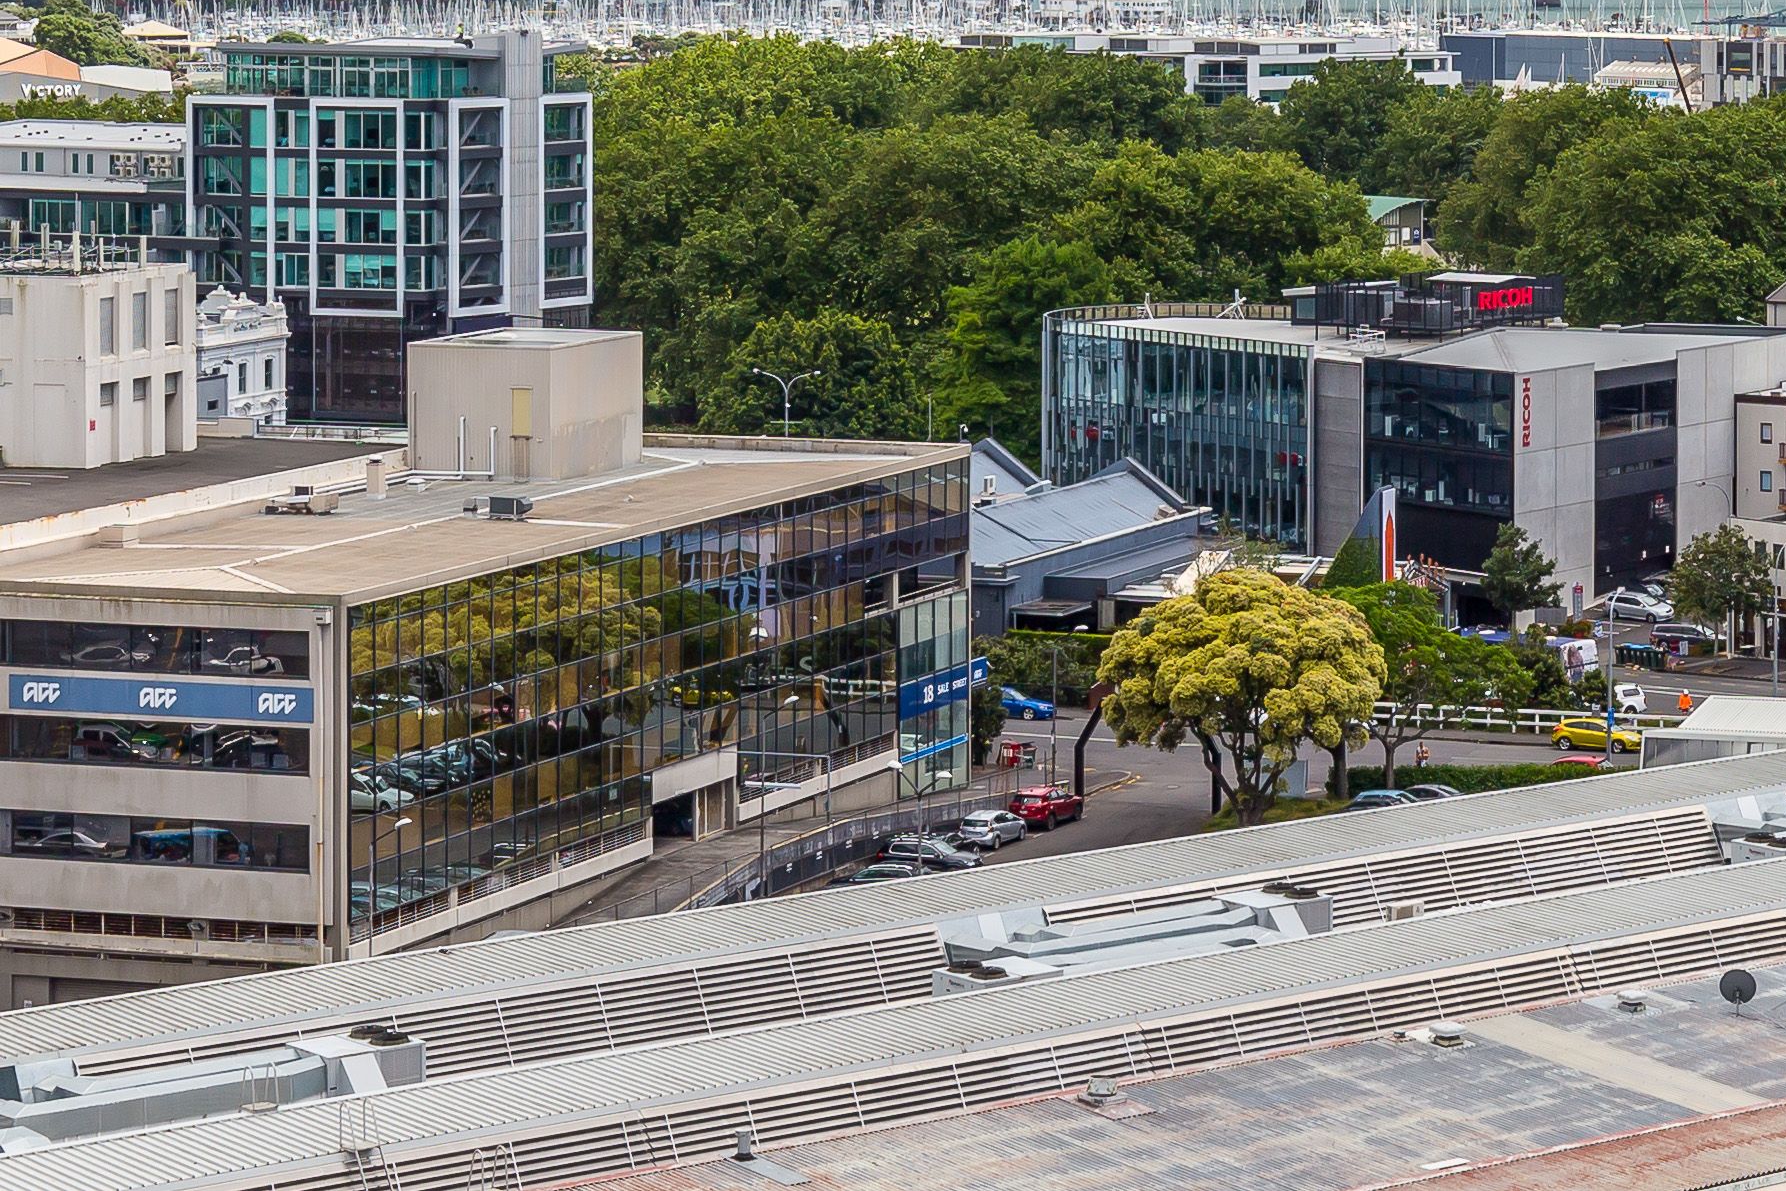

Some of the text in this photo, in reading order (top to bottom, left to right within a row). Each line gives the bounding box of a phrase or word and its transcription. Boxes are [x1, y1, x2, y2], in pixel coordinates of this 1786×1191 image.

[1477, 286, 1533, 310] RICOH
[1522, 377, 1531, 447] RICOH
[923, 684, 934, 705] 18
